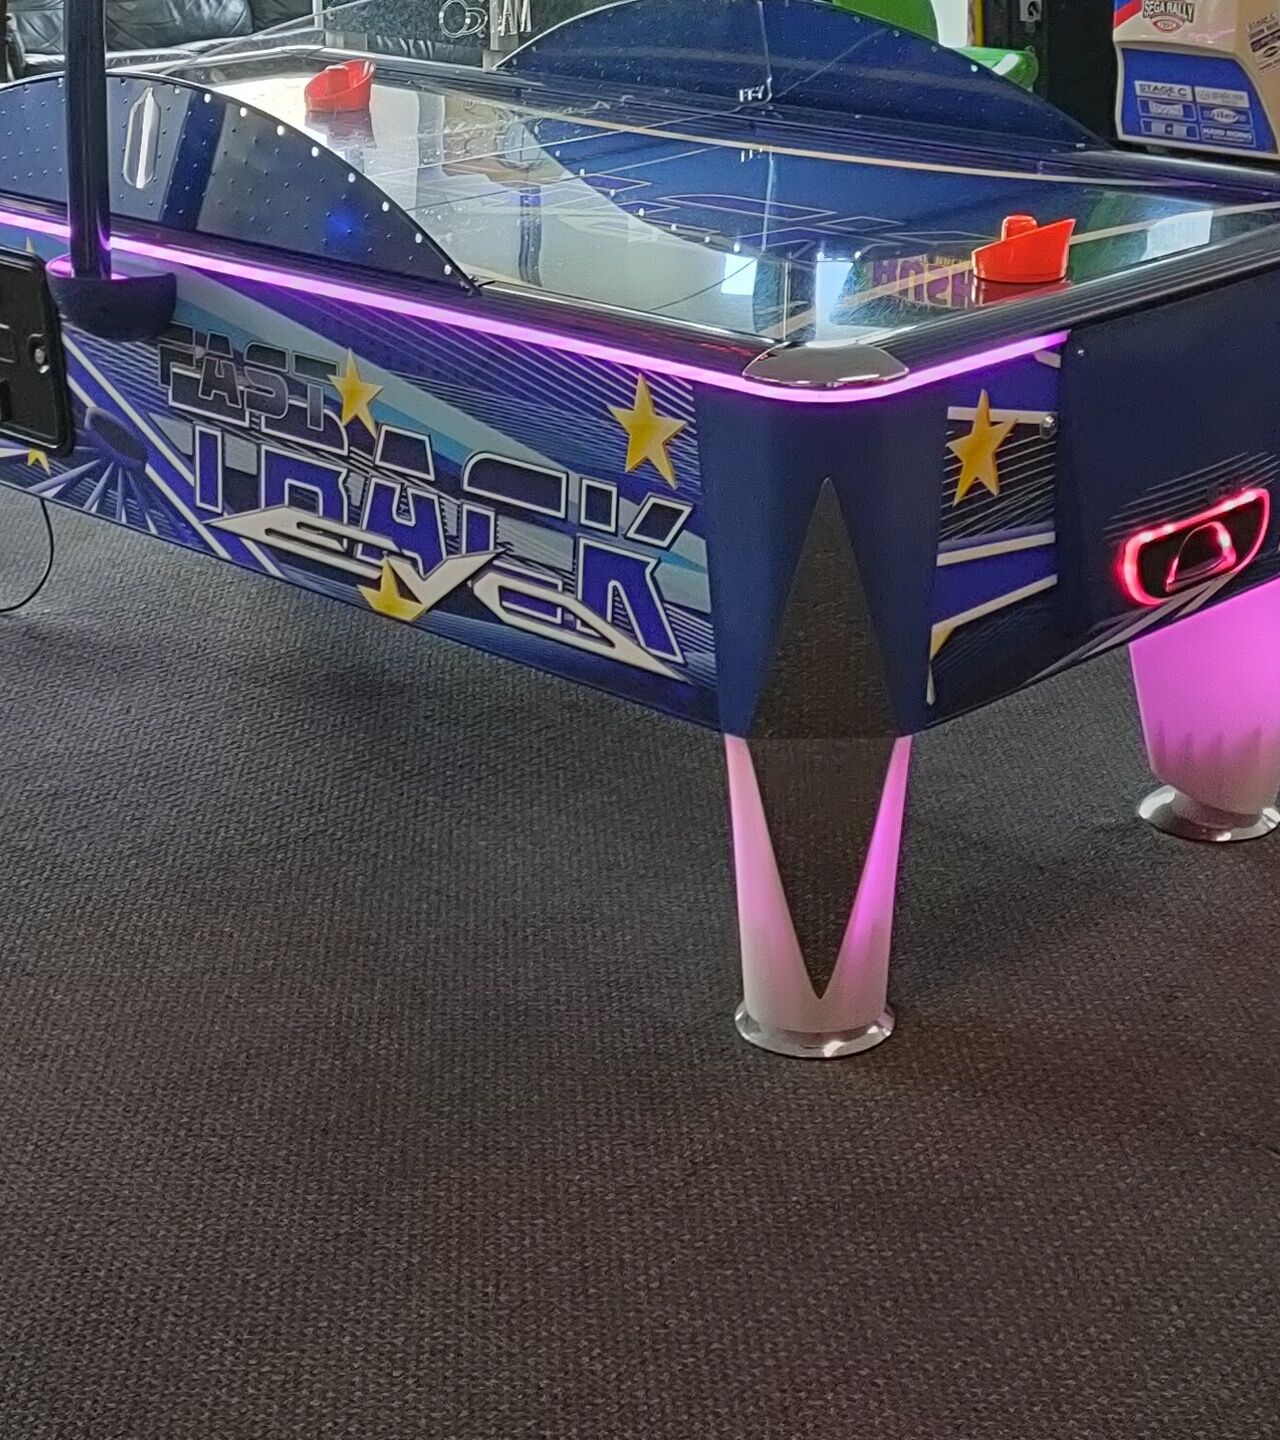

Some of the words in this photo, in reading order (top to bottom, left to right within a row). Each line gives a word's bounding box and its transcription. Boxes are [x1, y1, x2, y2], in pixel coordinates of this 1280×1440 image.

[1139, 82, 1177, 97] STAGE
[1178, 87, 1188, 98] C
[158, 322, 339, 432] FAST
[168, 368, 694, 666] TRACK
